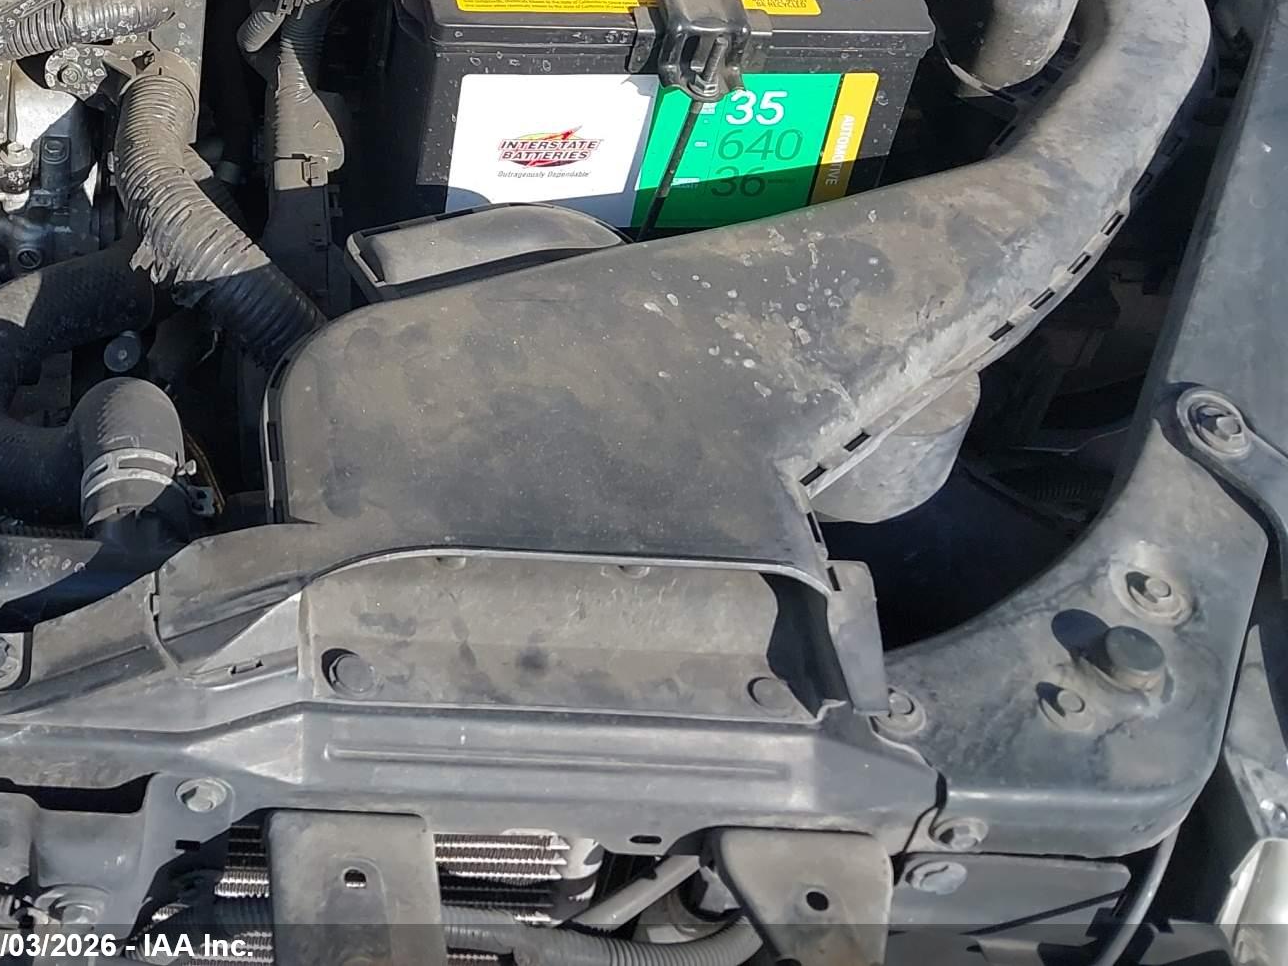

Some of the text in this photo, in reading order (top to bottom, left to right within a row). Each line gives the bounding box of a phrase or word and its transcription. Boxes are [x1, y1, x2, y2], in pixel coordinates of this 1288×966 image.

[725, 89, 789, 126] 35
[501, 140, 599, 150] INTERSTATE
[502, 151, 589, 160] BATTERIES
[717, 128, 804, 161] 640
[825, 115, 856, 186] AUTOMOTIVE
[497, 170, 546, 179] Outrageously
[711, 166, 766, 197] 36
